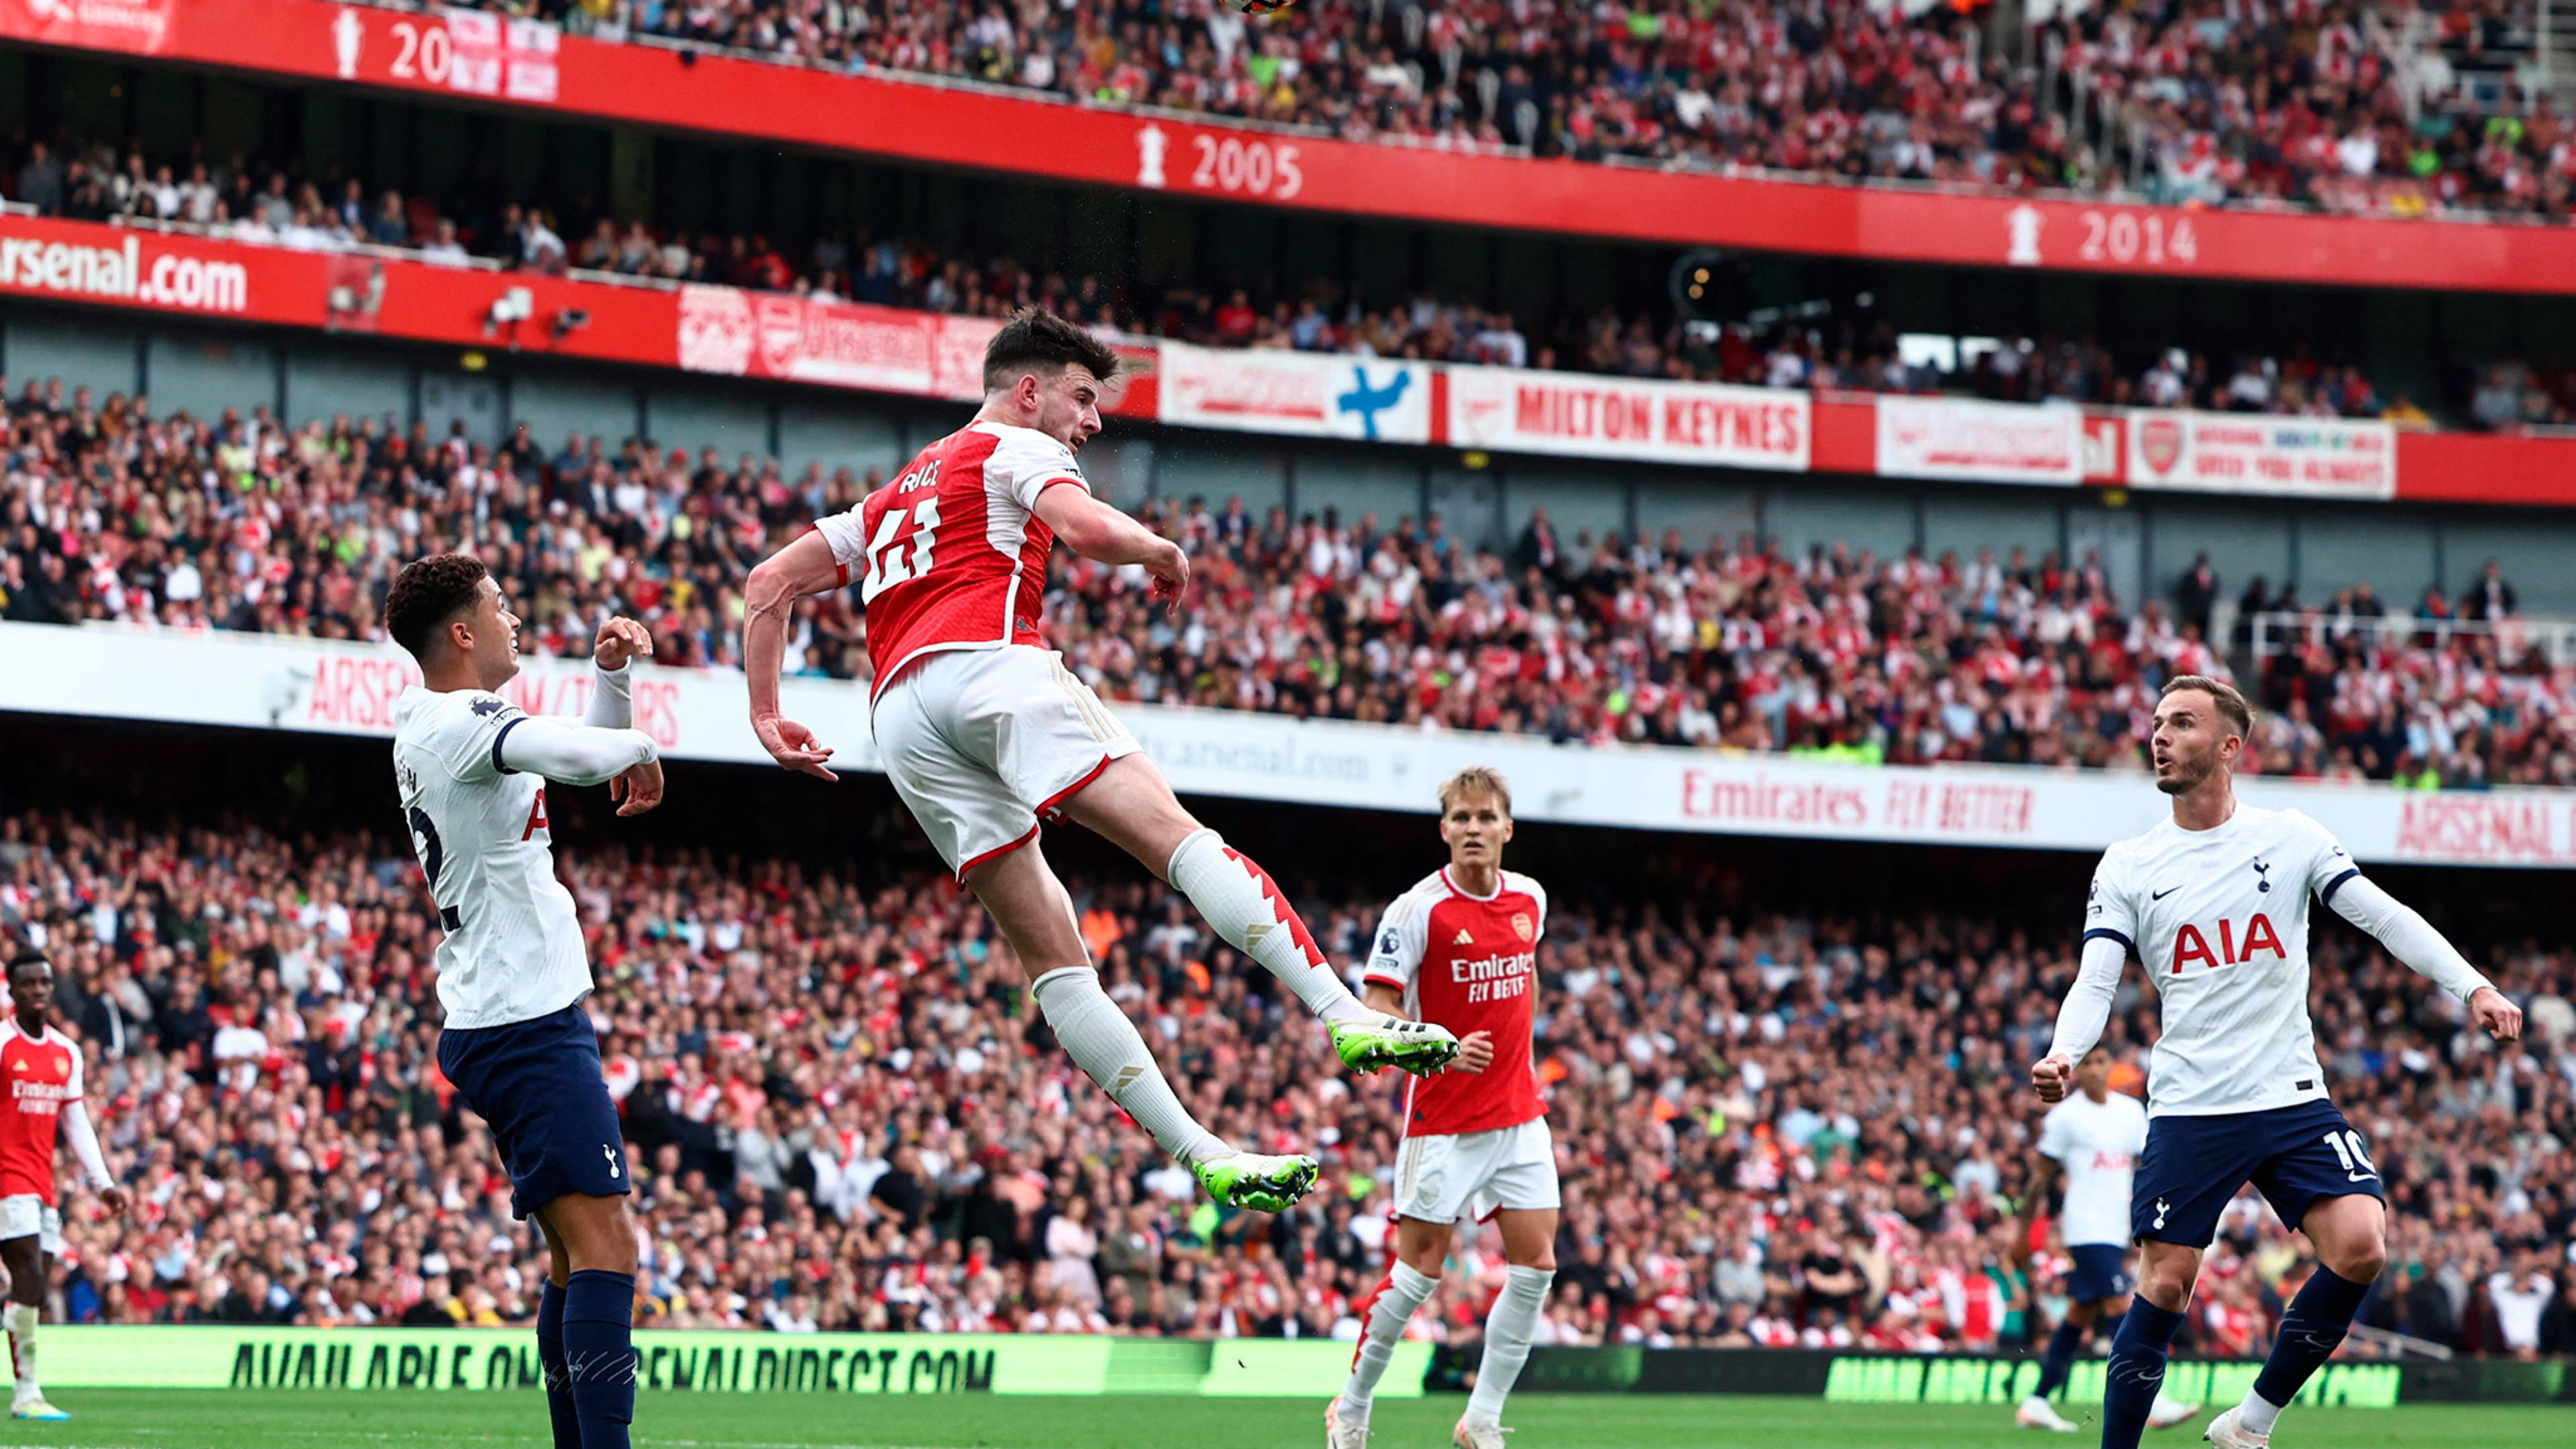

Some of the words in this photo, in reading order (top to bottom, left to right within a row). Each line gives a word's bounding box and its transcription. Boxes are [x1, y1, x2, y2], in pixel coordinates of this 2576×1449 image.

[389, 22, 451, 83] 20
[1191, 134, 1303, 200] 2005
[2079, 210, 2198, 266] 2014
[0, 235, 247, 311] rsenal.com
[1516, 384, 1651, 441] MILTON
[1664, 394, 1800, 455] KEYNES
[899, 460, 942, 494] RICE
[861, 494, 943, 606] 41
[1682, 769, 1867, 825] Emirates
[1885, 780, 1929, 829] FLY
[1938, 784, 2034, 833] BETTER
[2396, 798, 2553, 862] ARSENAL
[1451, 953, 1535, 982] Emirate
[2172, 913, 2286, 974] AIA
[1468, 981, 1490, 1003] FLY
[2322, 1130, 2377, 1173] 10
[231, 1343, 472, 1387] AVAILABLE
